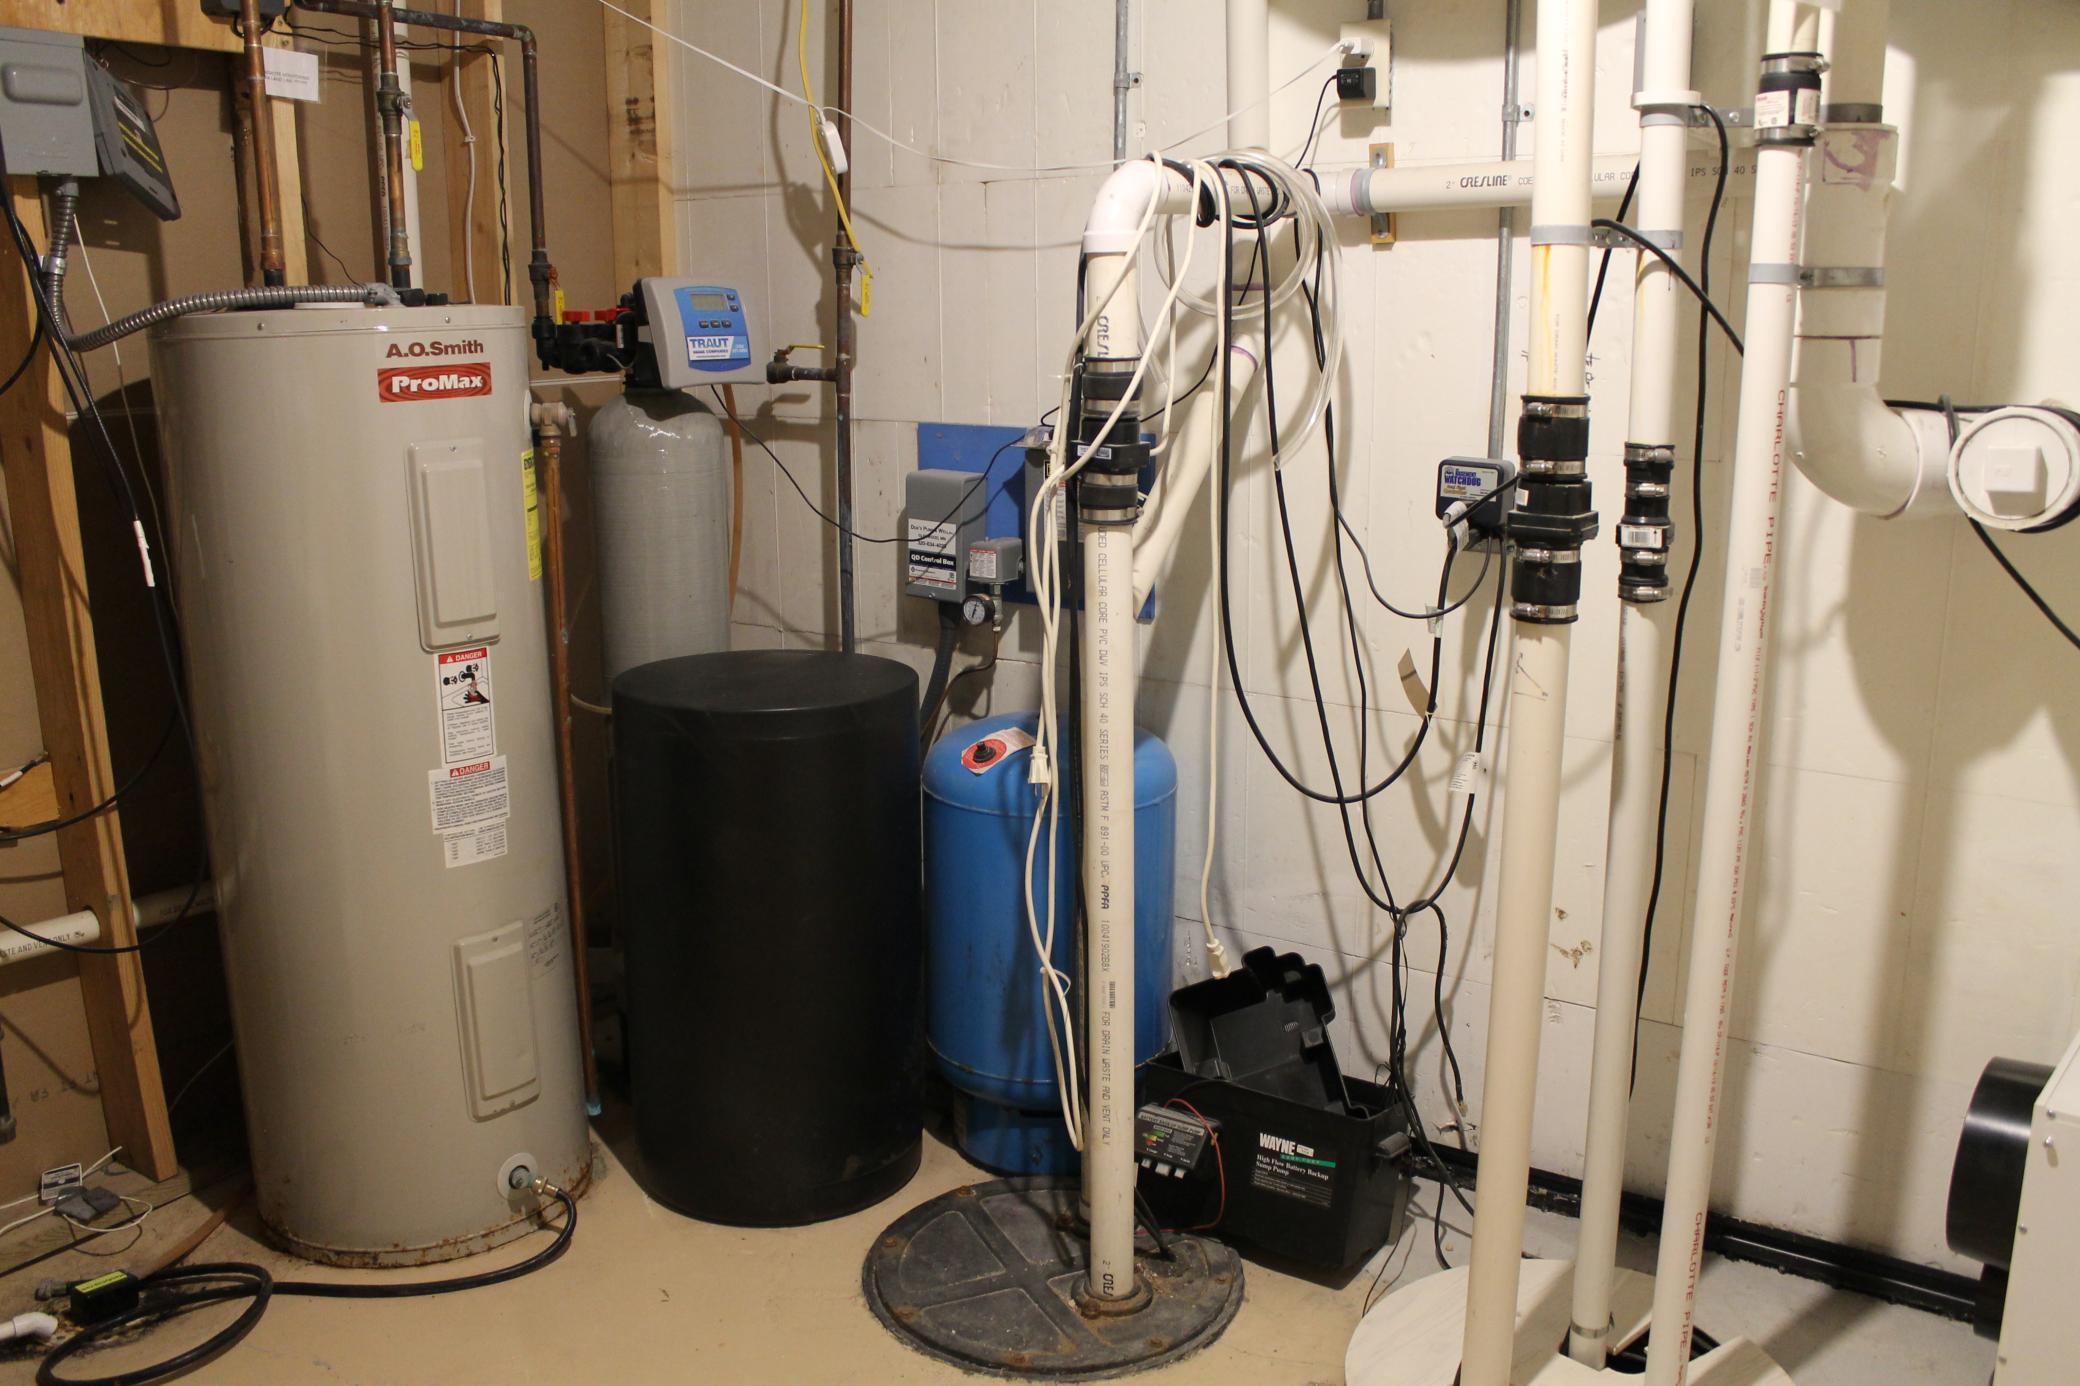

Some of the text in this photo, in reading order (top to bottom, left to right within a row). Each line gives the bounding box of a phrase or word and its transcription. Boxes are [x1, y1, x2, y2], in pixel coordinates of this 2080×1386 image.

[1690, 167, 1706, 177] IPS
[1734, 166, 1745, 176] 40
[1460, 176, 1508, 188] CRESLINE
[689, 338, 728, 348] TRAUT
[391, 373, 483, 394] ProMax
[1444, 475, 1481, 486] WATCHDOG
[1762, 389, 1786, 566] CHARLOTTE PIPE
[920, 556, 942, 564] Control
[1098, 552, 1108, 597] CELLULAR
[1098, 601, 1108, 624] CORE
[1099, 628, 1108, 645] PVC
[455, 650, 482, 662] DANGER
[1099, 649, 1108, 666] DWV
[1099, 672, 1109, 687] IPS
[1099, 692, 1109, 708] SCH
[1100, 713, 1109, 724] 40
[1100, 728, 1110, 760] SERIES
[459, 762, 490, 776] DANGER
[1100, 790, 1110, 812] ASTM
[1101, 884, 1110, 909] PPFA
[18, 943, 32, 953] AND
[1102, 1010, 1111, 1026] FOR
[1102, 1030, 1111, 1055] DRAIN
[1102, 1058, 1111, 1082] WASTE
[1102, 1086, 1111, 1101] AND
[1102, 1104, 1112, 1124] VENT
[1102, 1126, 1112, 1146] ONLY
[1260, 1132, 1296, 1156] WAYNE
[1256, 1154, 1270, 1164] High
[1271, 1156, 1284, 1166] Flow
[1286, 1162, 1306, 1175] Battery
[1308, 1168, 1329, 1180] Backup
[1256, 1160, 1290, 1176] Sump Pump
[1680, 1212, 1703, 1348] CHARLOTTE PIPE
